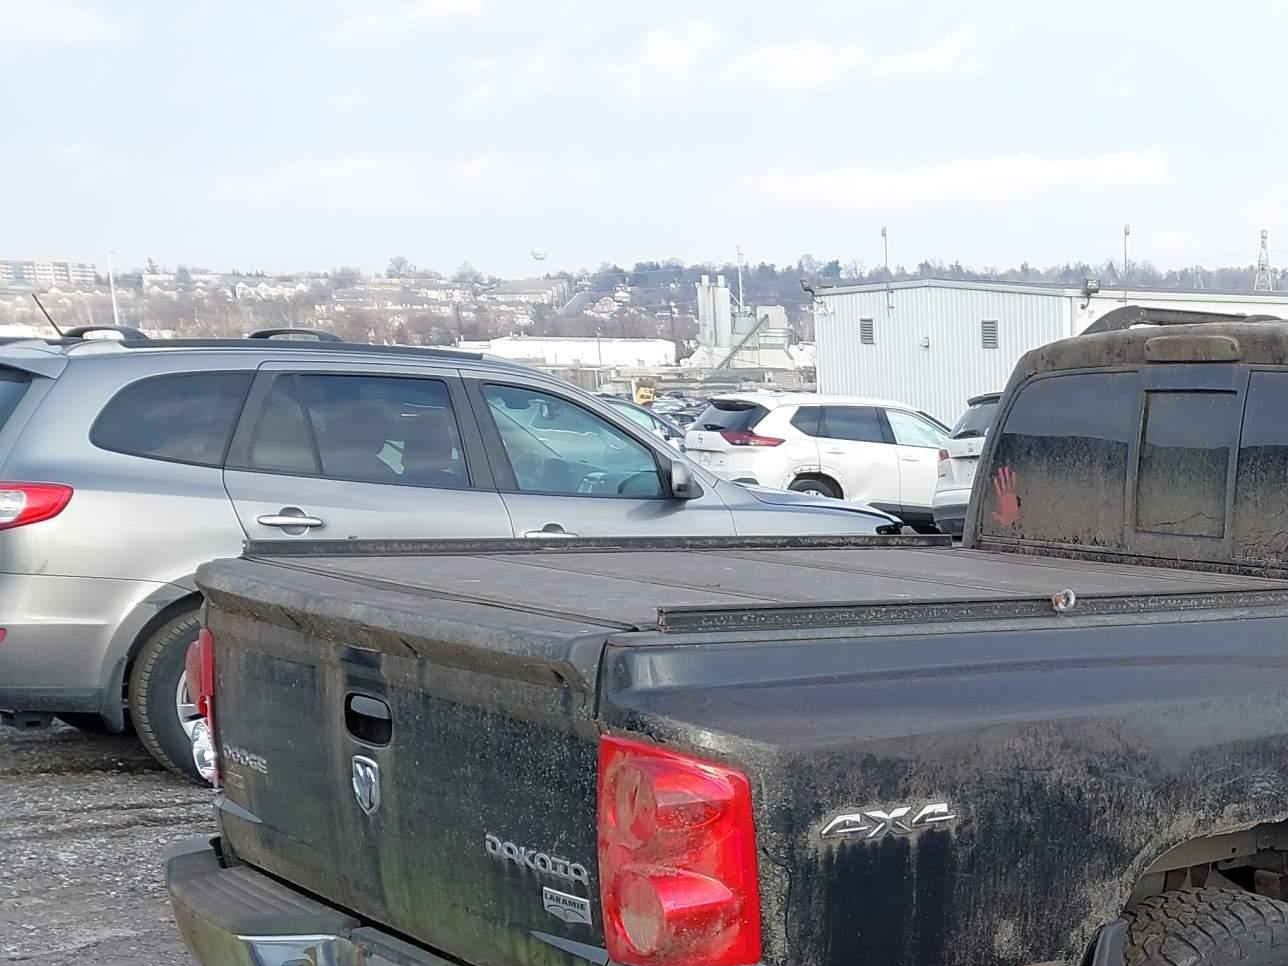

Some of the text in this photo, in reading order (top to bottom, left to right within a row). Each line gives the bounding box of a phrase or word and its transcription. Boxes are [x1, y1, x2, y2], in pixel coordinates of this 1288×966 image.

[223, 744, 268, 775] DODGE
[485, 833, 588, 885] DAKOTA
[544, 893, 586, 911] LARAMIE
